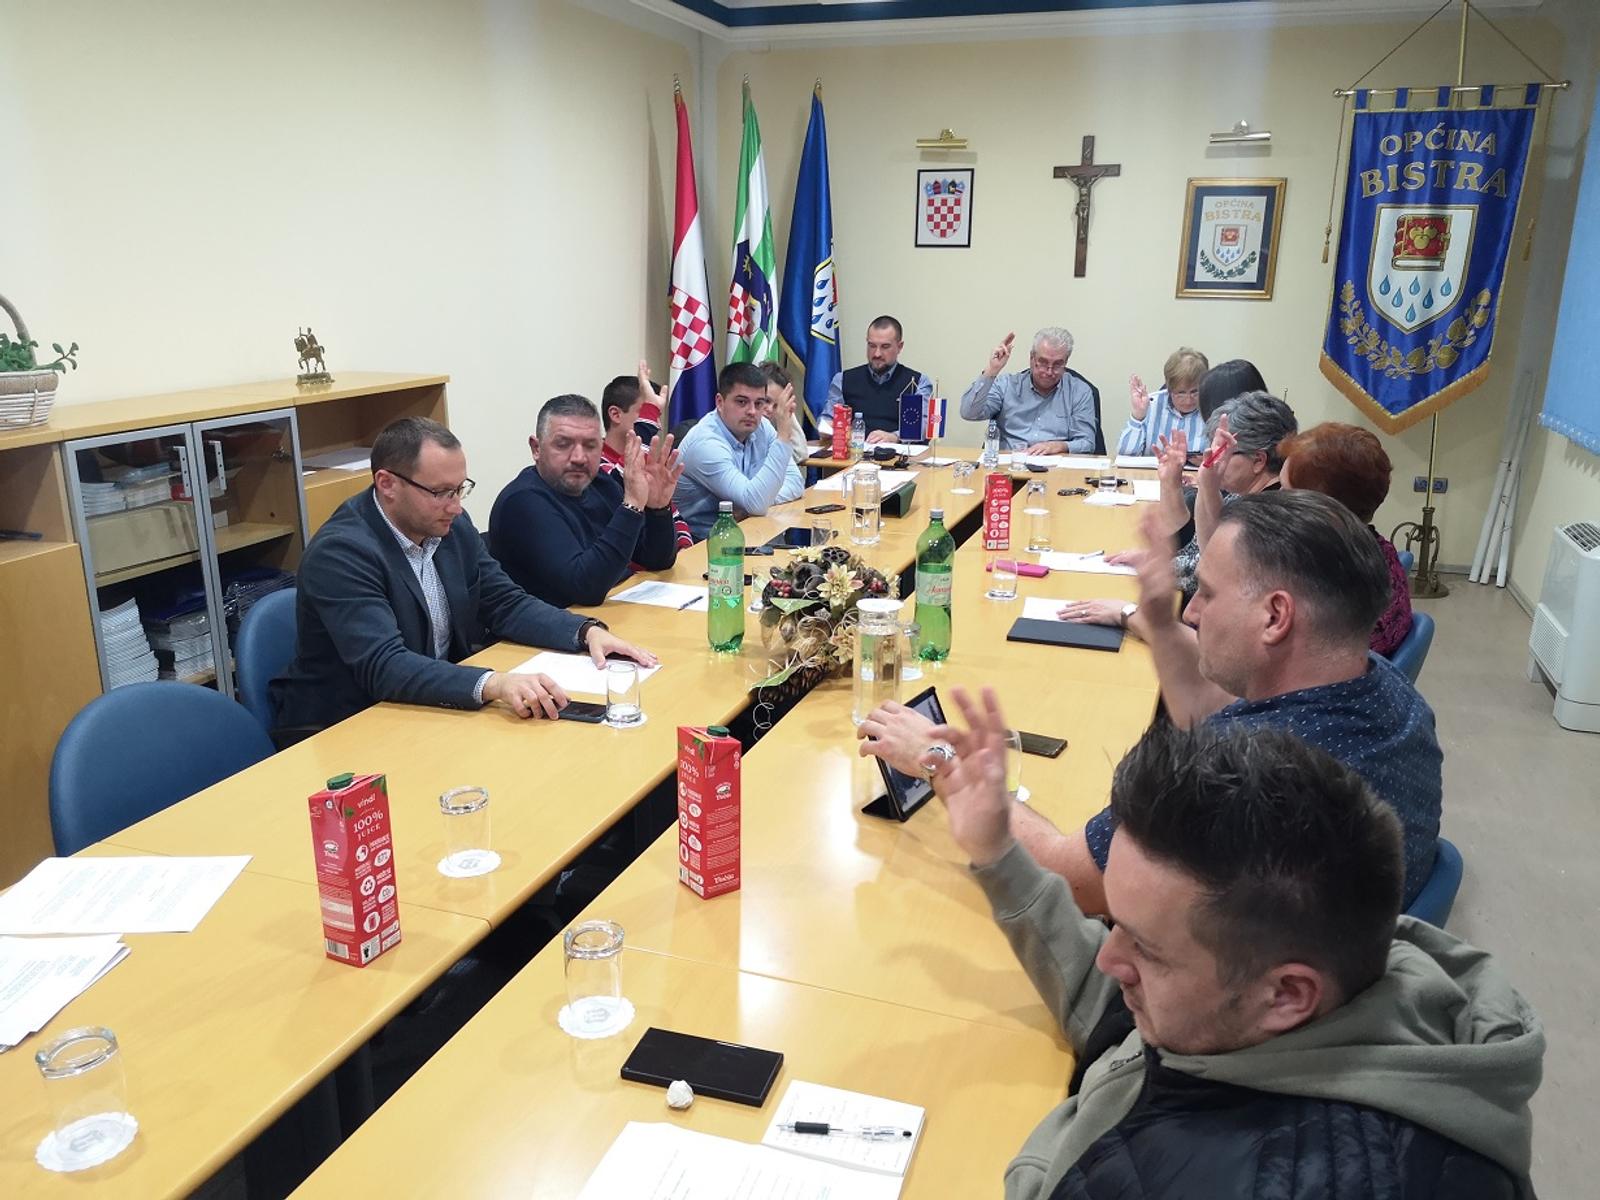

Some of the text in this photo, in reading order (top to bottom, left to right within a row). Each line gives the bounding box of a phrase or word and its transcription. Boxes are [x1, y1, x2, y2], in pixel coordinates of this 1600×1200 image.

[1379, 122, 1496, 156] OPĆINA
[1360, 160, 1507, 199] BISTRA
[1205, 209, 1262, 222] BISTRA
[353, 810, 384, 833] 100%
[358, 823, 381, 841] JUICE
